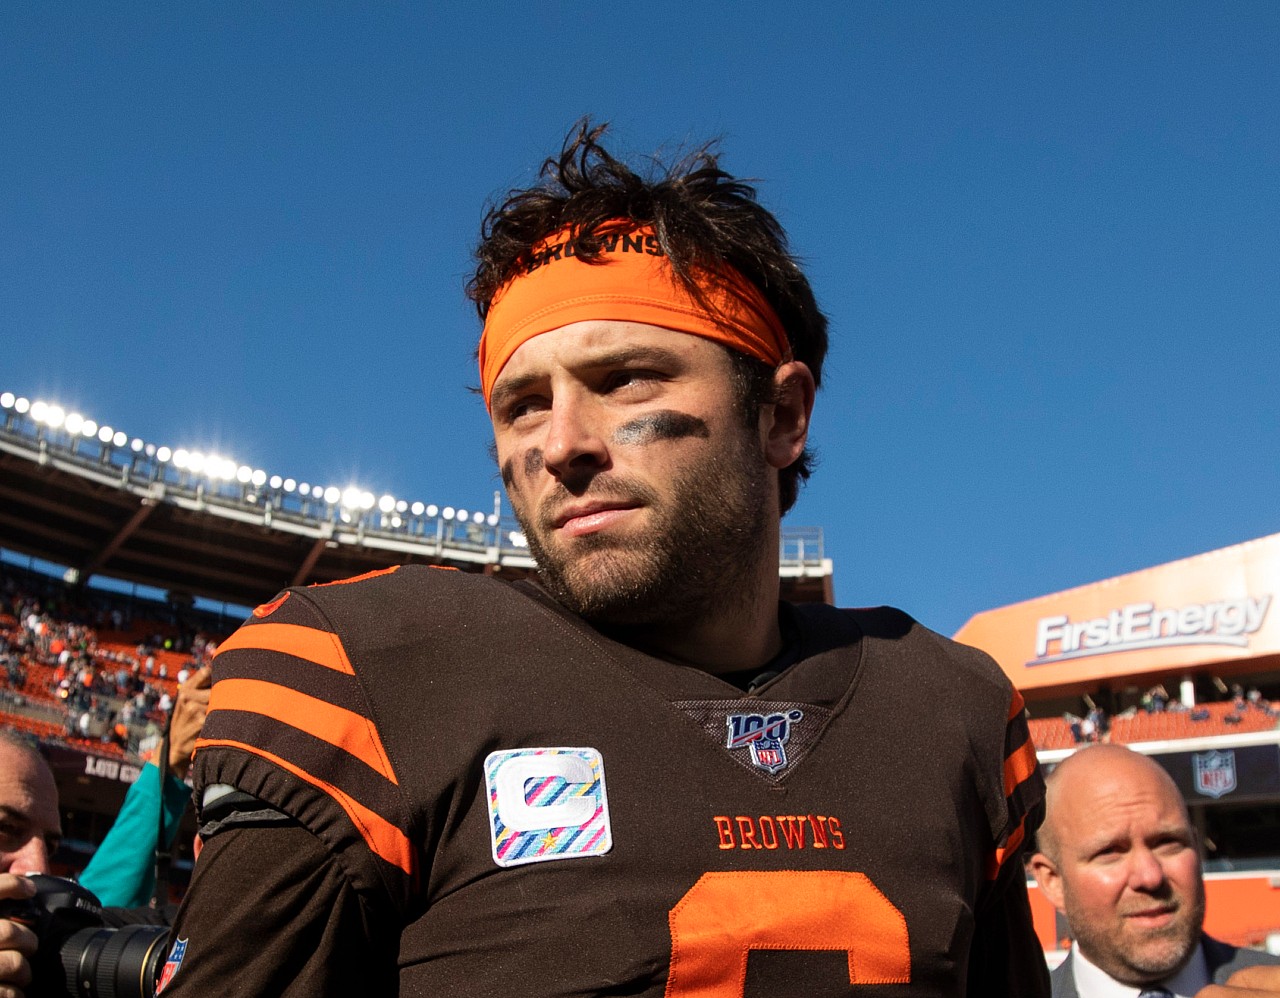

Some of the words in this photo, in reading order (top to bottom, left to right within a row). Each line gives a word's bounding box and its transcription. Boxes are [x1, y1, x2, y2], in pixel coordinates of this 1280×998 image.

[1036, 594, 1272, 657] FirstEnergy
[730, 715, 787, 742] 100
[713, 814, 847, 850] BROWNS
